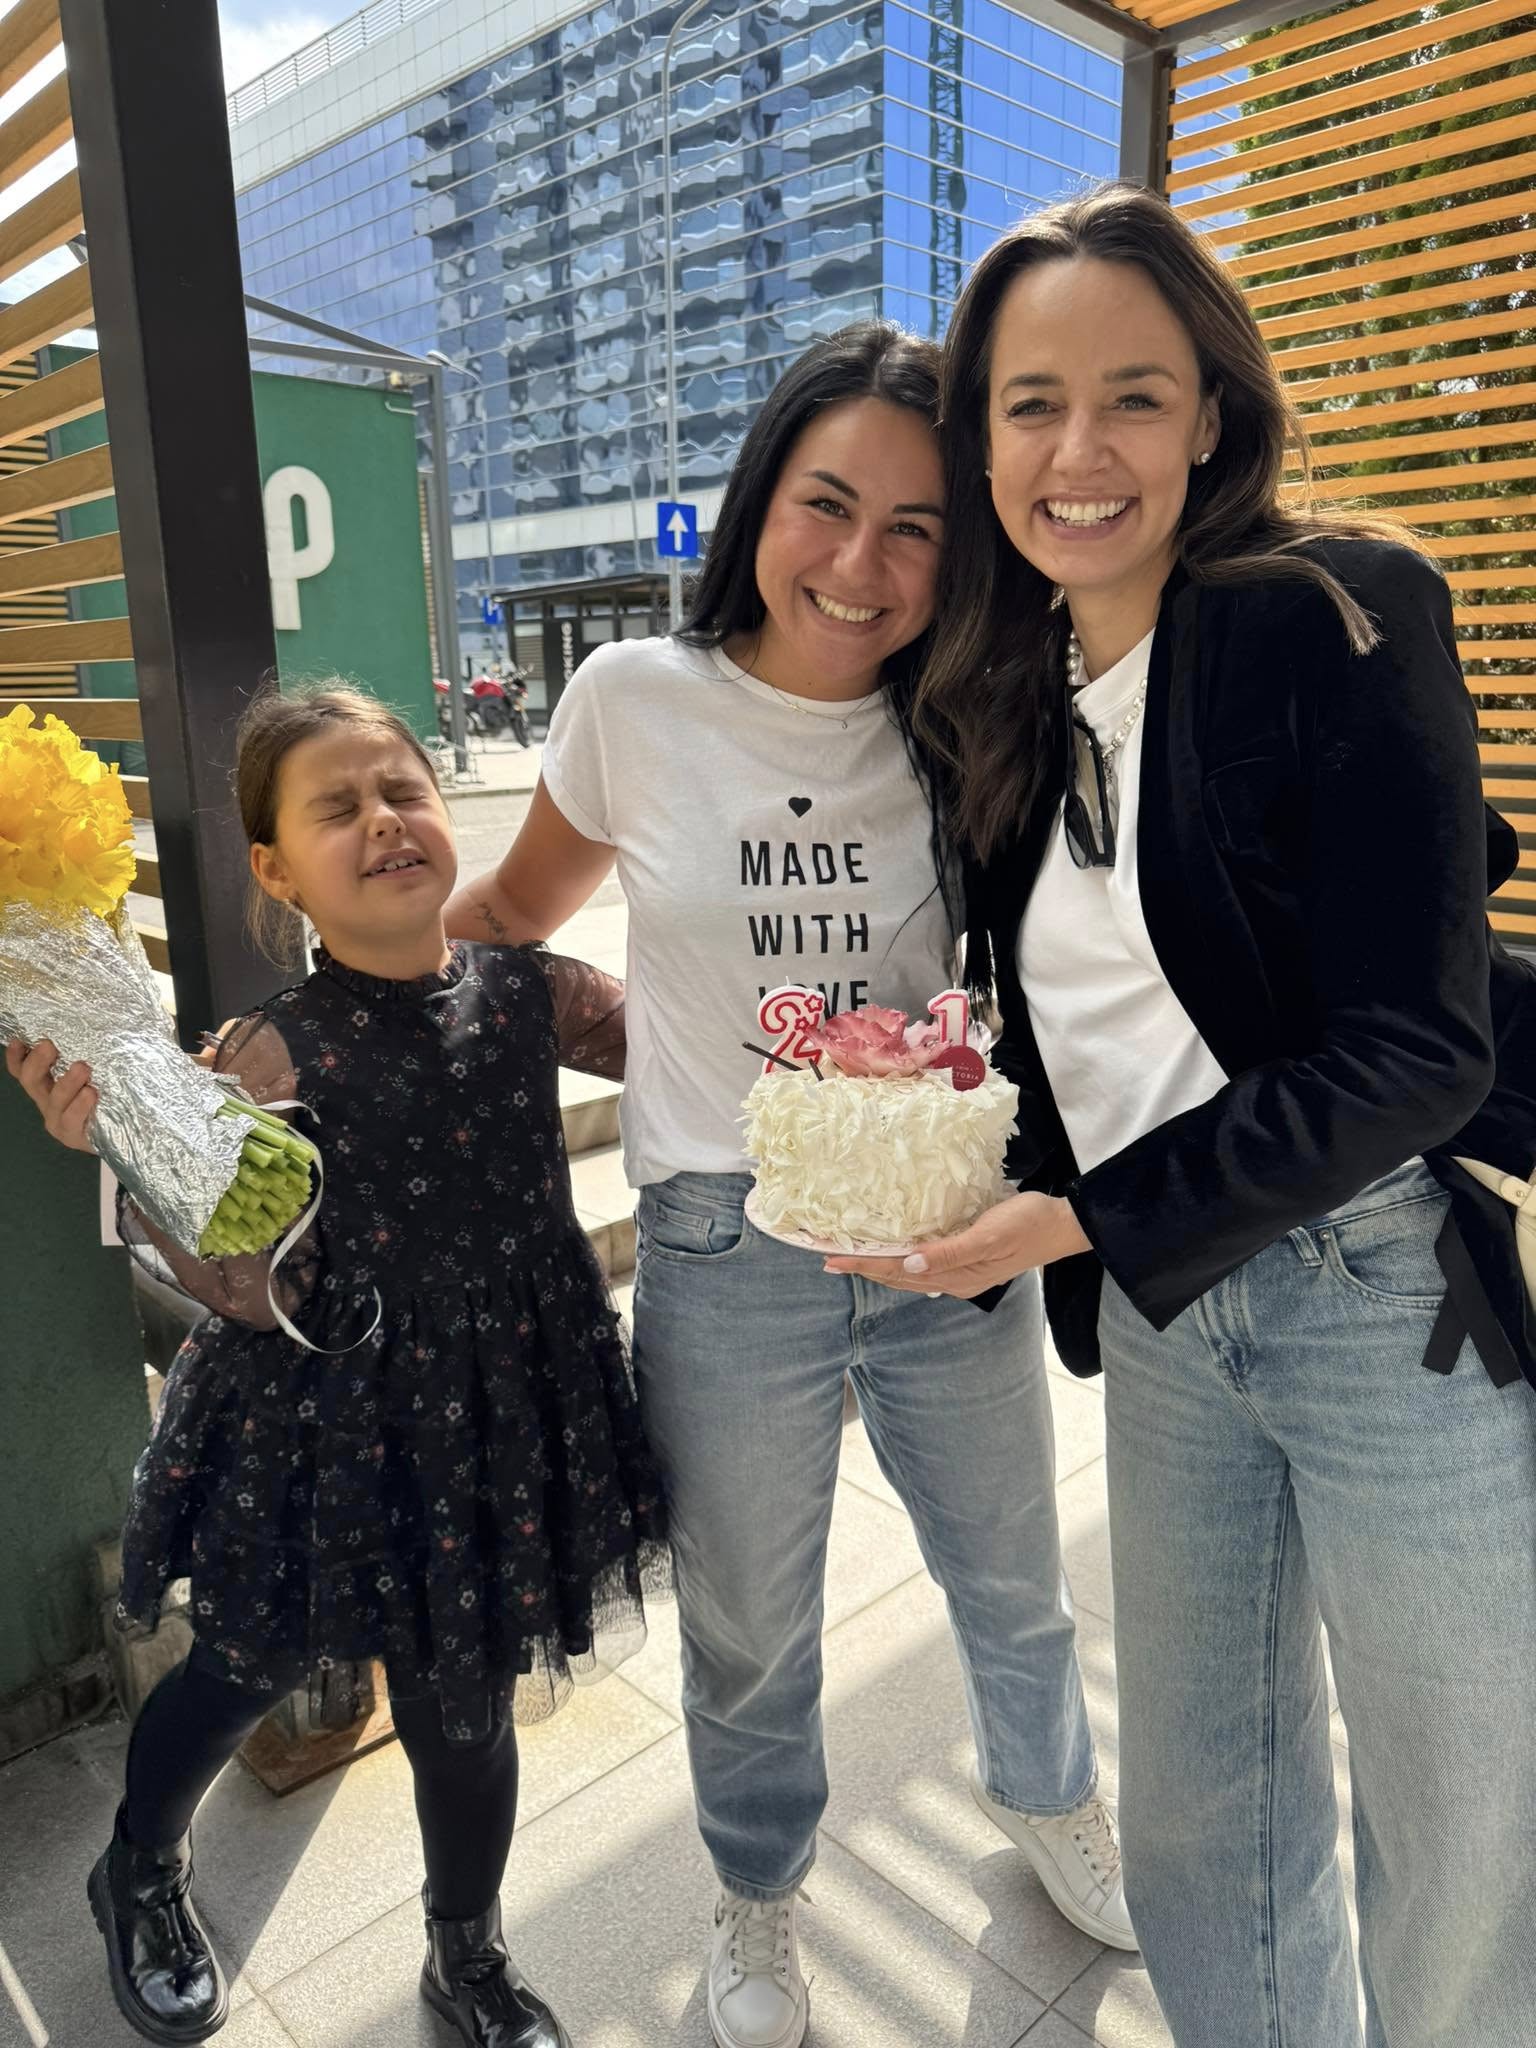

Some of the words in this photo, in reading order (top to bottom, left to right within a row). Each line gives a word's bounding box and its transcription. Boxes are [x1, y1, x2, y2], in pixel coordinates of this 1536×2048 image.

[741, 840, 869, 886] MADE
[748, 913, 869, 956] WITH
[759, 980, 869, 1021] VE
